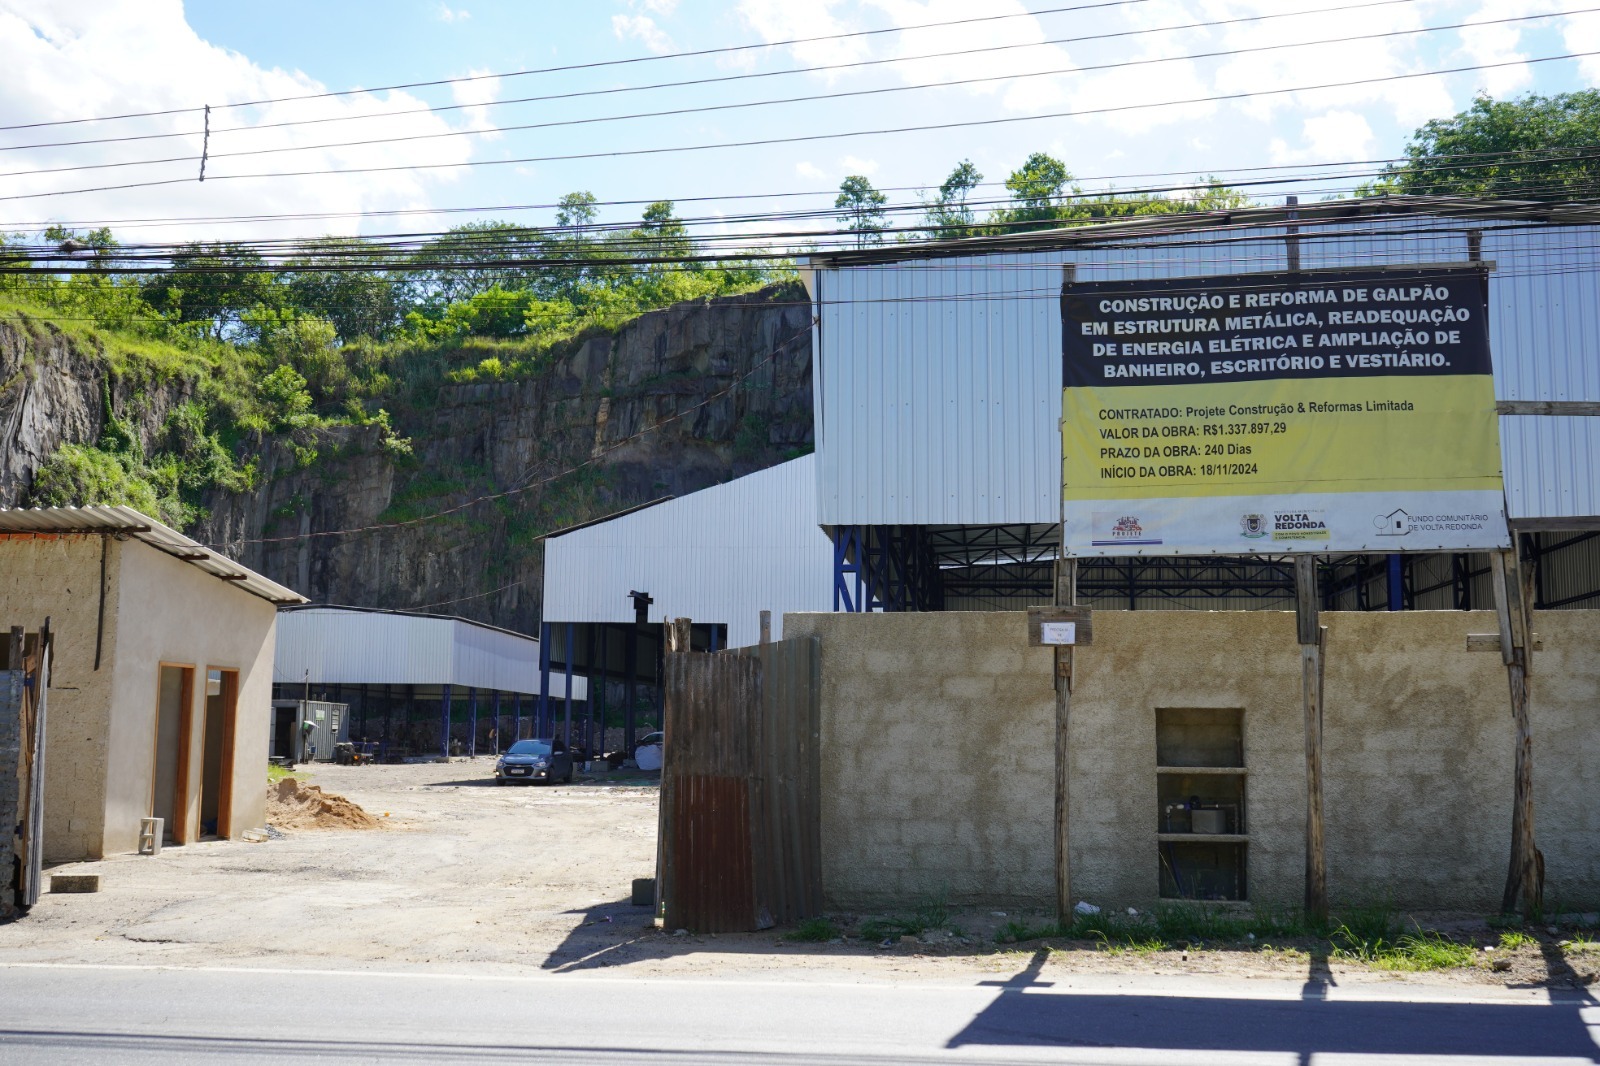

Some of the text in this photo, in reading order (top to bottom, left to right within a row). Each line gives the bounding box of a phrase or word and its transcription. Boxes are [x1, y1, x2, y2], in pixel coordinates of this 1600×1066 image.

[1100, 284, 1449, 314] CONSTRUÇÃO E REFORMA DE GALPÃO
[1082, 306, 1470, 335] EM ESTRUTURA METÁLICA, READEQUAÇÃO
[1093, 328, 1460, 356] DE ENERGIA ELÉTRICA E AMPLIAÇÃO DE
[1104, 350, 1450, 378] BANHEIRO, ESCRITÓRIO E VESTIÁRIO.
[1099, 400, 1414, 420] CONTRATADO: Projete Construção & Reformas Limitada
[1100, 422, 1286, 440] VALOR DA OBRA: R$1.337.897,29
[1100, 444, 1252, 458] PRAZO DA OBRA: 240 Dias
[1101, 463, 1258, 478] INÍCIO DA OBRA: 18/11/2024
[1275, 522, 1326, 530] REDONDA
